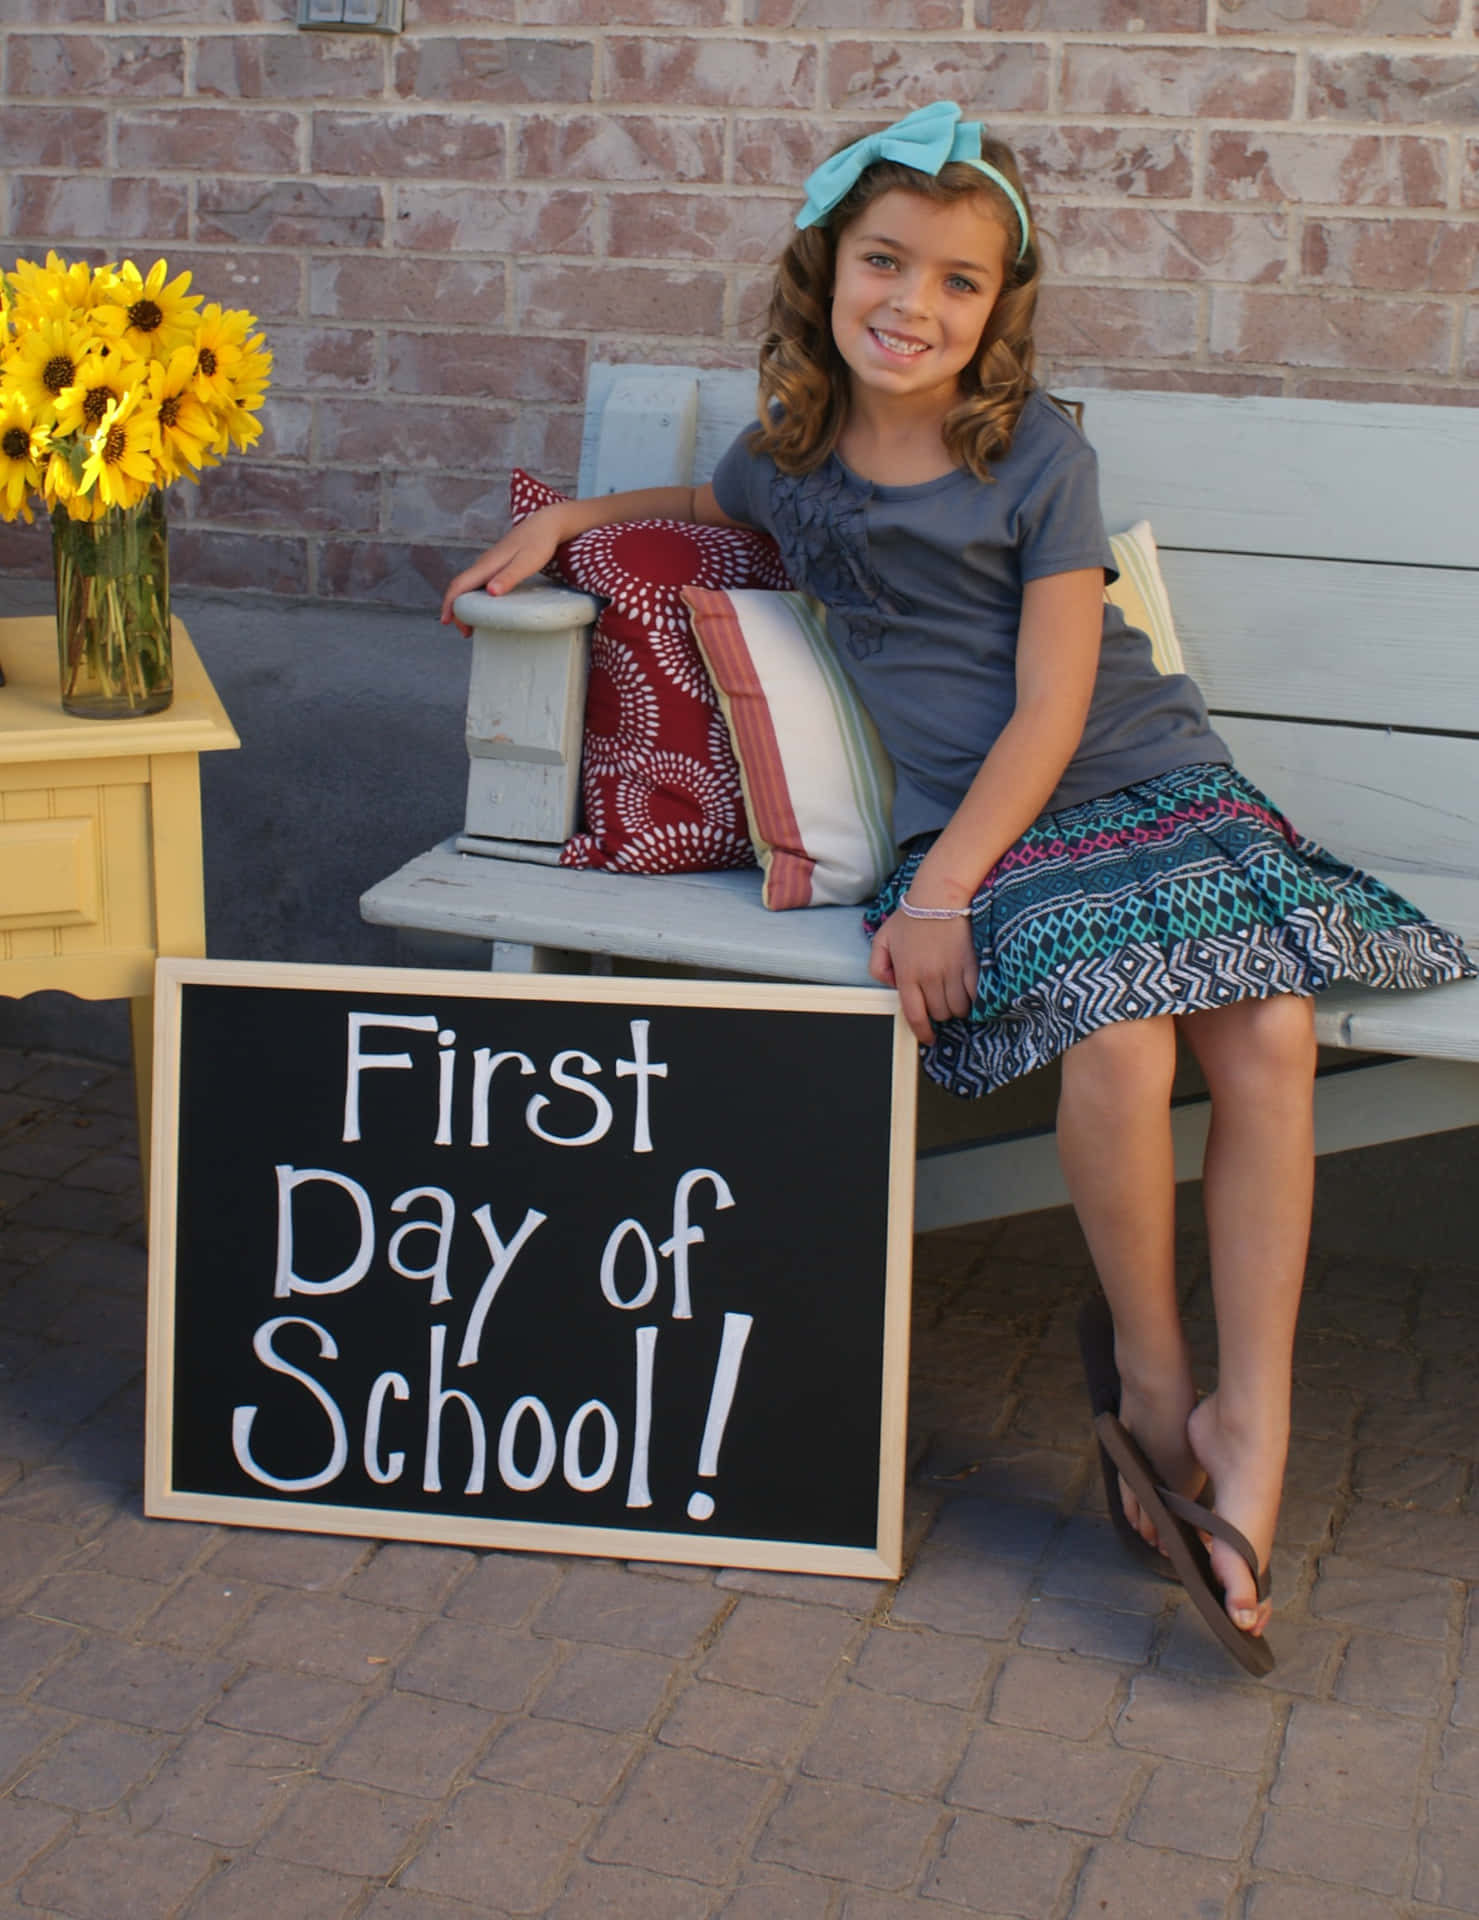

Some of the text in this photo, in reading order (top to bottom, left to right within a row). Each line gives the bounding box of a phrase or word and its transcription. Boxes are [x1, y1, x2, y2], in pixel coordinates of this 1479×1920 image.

[343, 1012, 668, 1153] First
[274, 1165, 736, 1367] Day of
